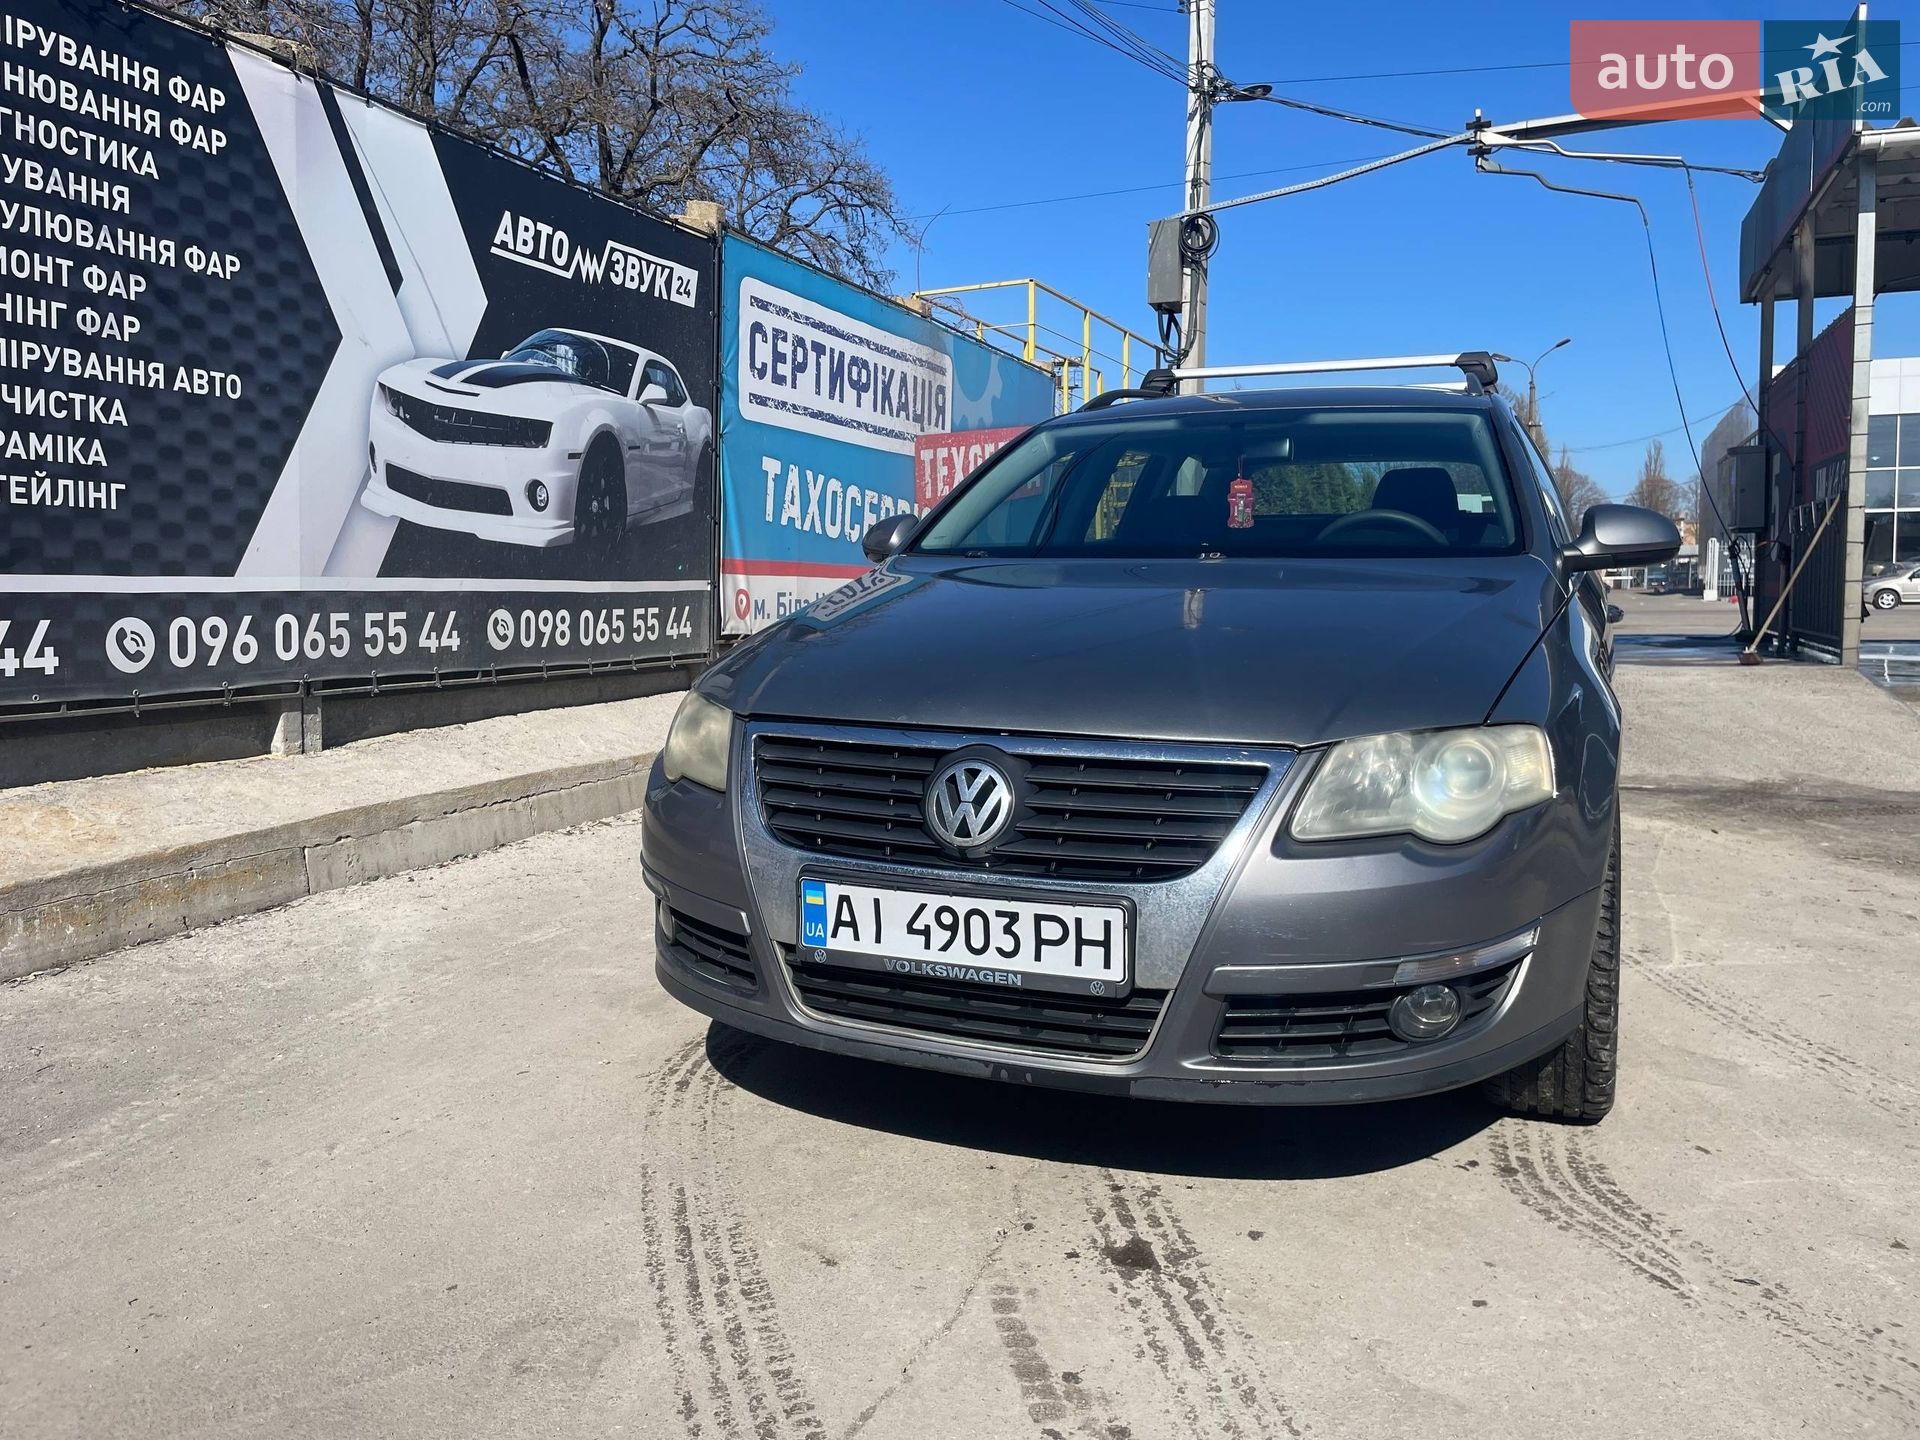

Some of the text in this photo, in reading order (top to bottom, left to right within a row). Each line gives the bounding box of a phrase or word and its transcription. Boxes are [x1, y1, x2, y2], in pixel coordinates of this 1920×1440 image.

[0, 15, 226, 114] ІРУВАННЯ ФАР
[4, 61, 227, 155] НЮВАННЯ ФАР
[0, 107, 159, 180] ГНОСТИКА
[2, 153, 130, 214] УВАННЯ
[0, 200, 241, 280] УЛЮВАННЯ ФАР
[493, 210, 692, 300] АВТО ЗВУК 24
[0, 246, 147, 301] ОНТ ФАР
[76, 306, 141, 342] ФАР
[1, 384, 129, 427] ЧИСТКА
[173, 366, 242, 400] АВТО
[749, 320, 948, 433] СЕРТИФІКАЦІЯ
[0, 430, 108, 467] АМІКА
[169, 610, 461, 668] 096 065 55 44
[520, 605, 692, 648] 098 065 55 44
[806, 921, 825, 938] UA
[831, 894, 1111, 970] AI 4903 PH
[884, 958, 1022, 986] VOLKSWAGEN
